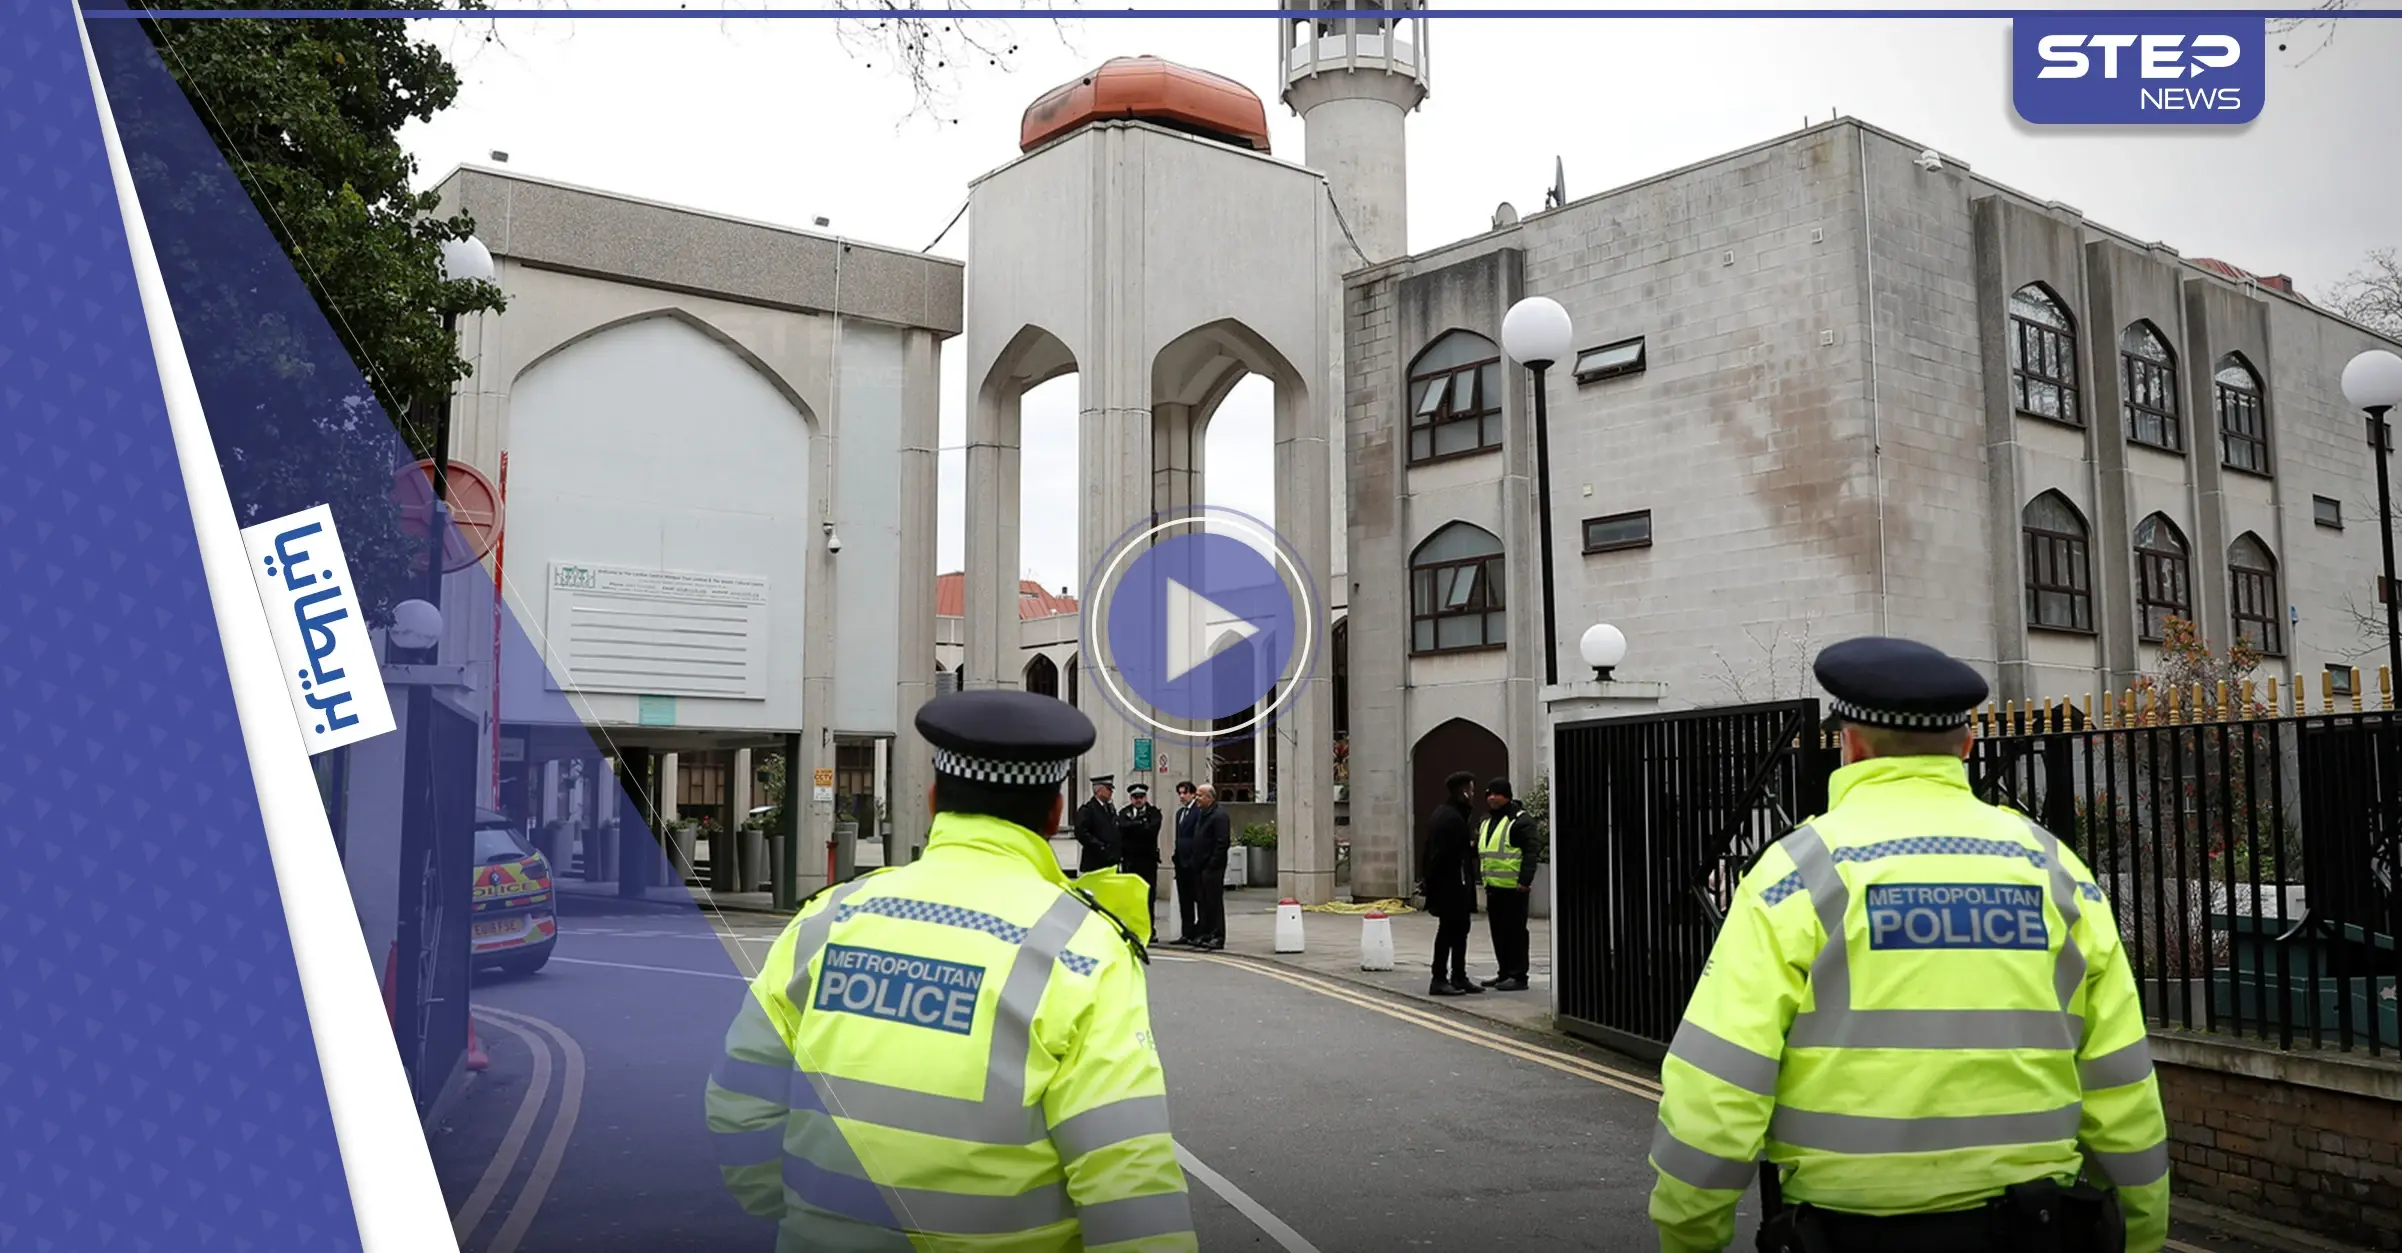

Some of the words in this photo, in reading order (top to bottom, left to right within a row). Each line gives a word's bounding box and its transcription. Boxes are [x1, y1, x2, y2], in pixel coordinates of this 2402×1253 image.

[473, 882, 533, 898] OLICE
[1869, 886, 2041, 906] METROPOLITAN
[1873, 908, 2047, 945] POLICE
[826, 949, 983, 988] METROPOLITAN
[819, 970, 976, 1031] POLICE
